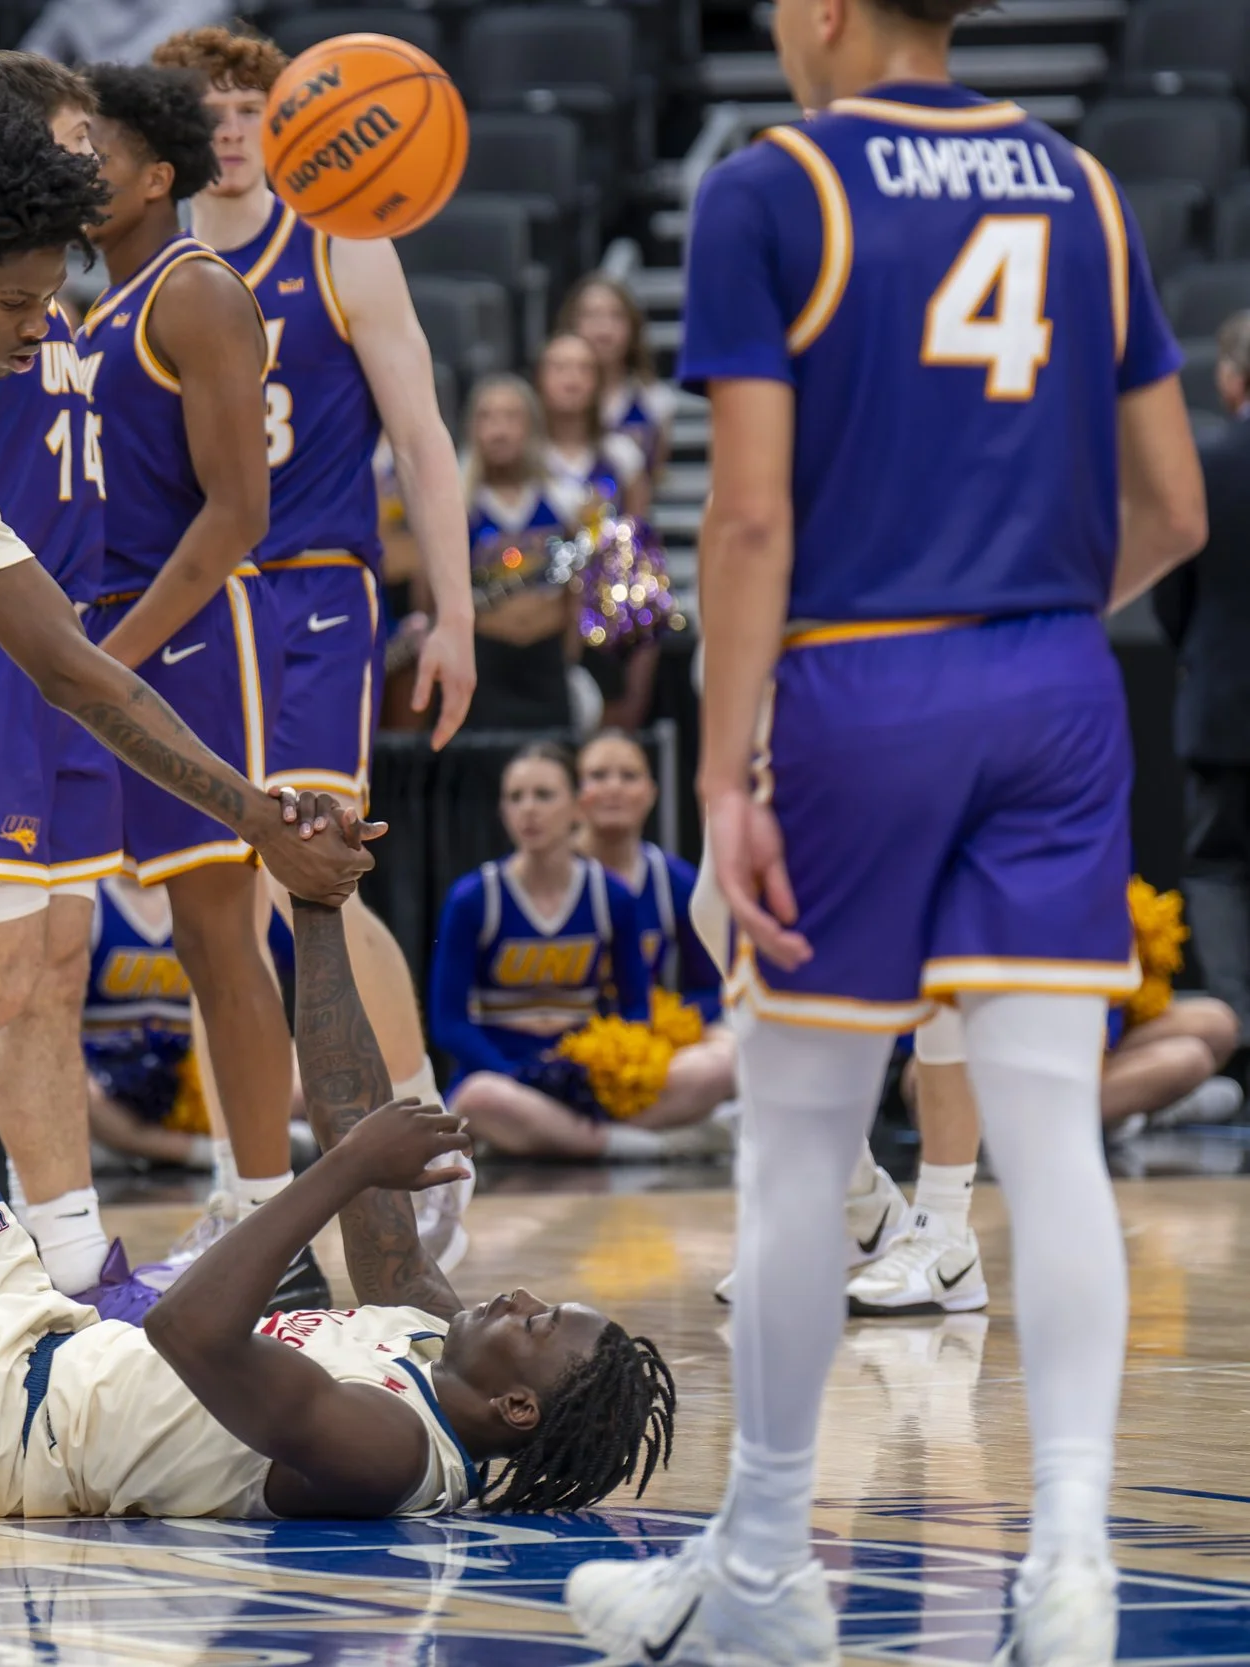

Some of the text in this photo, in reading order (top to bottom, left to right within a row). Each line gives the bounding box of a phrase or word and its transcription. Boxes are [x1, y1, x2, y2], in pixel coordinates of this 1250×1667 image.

[285, 104, 401, 193] Wilson
[865, 135, 1076, 203] CAMPBELL
[919, 213, 1053, 403] 4
[493, 934, 597, 988] UNI
